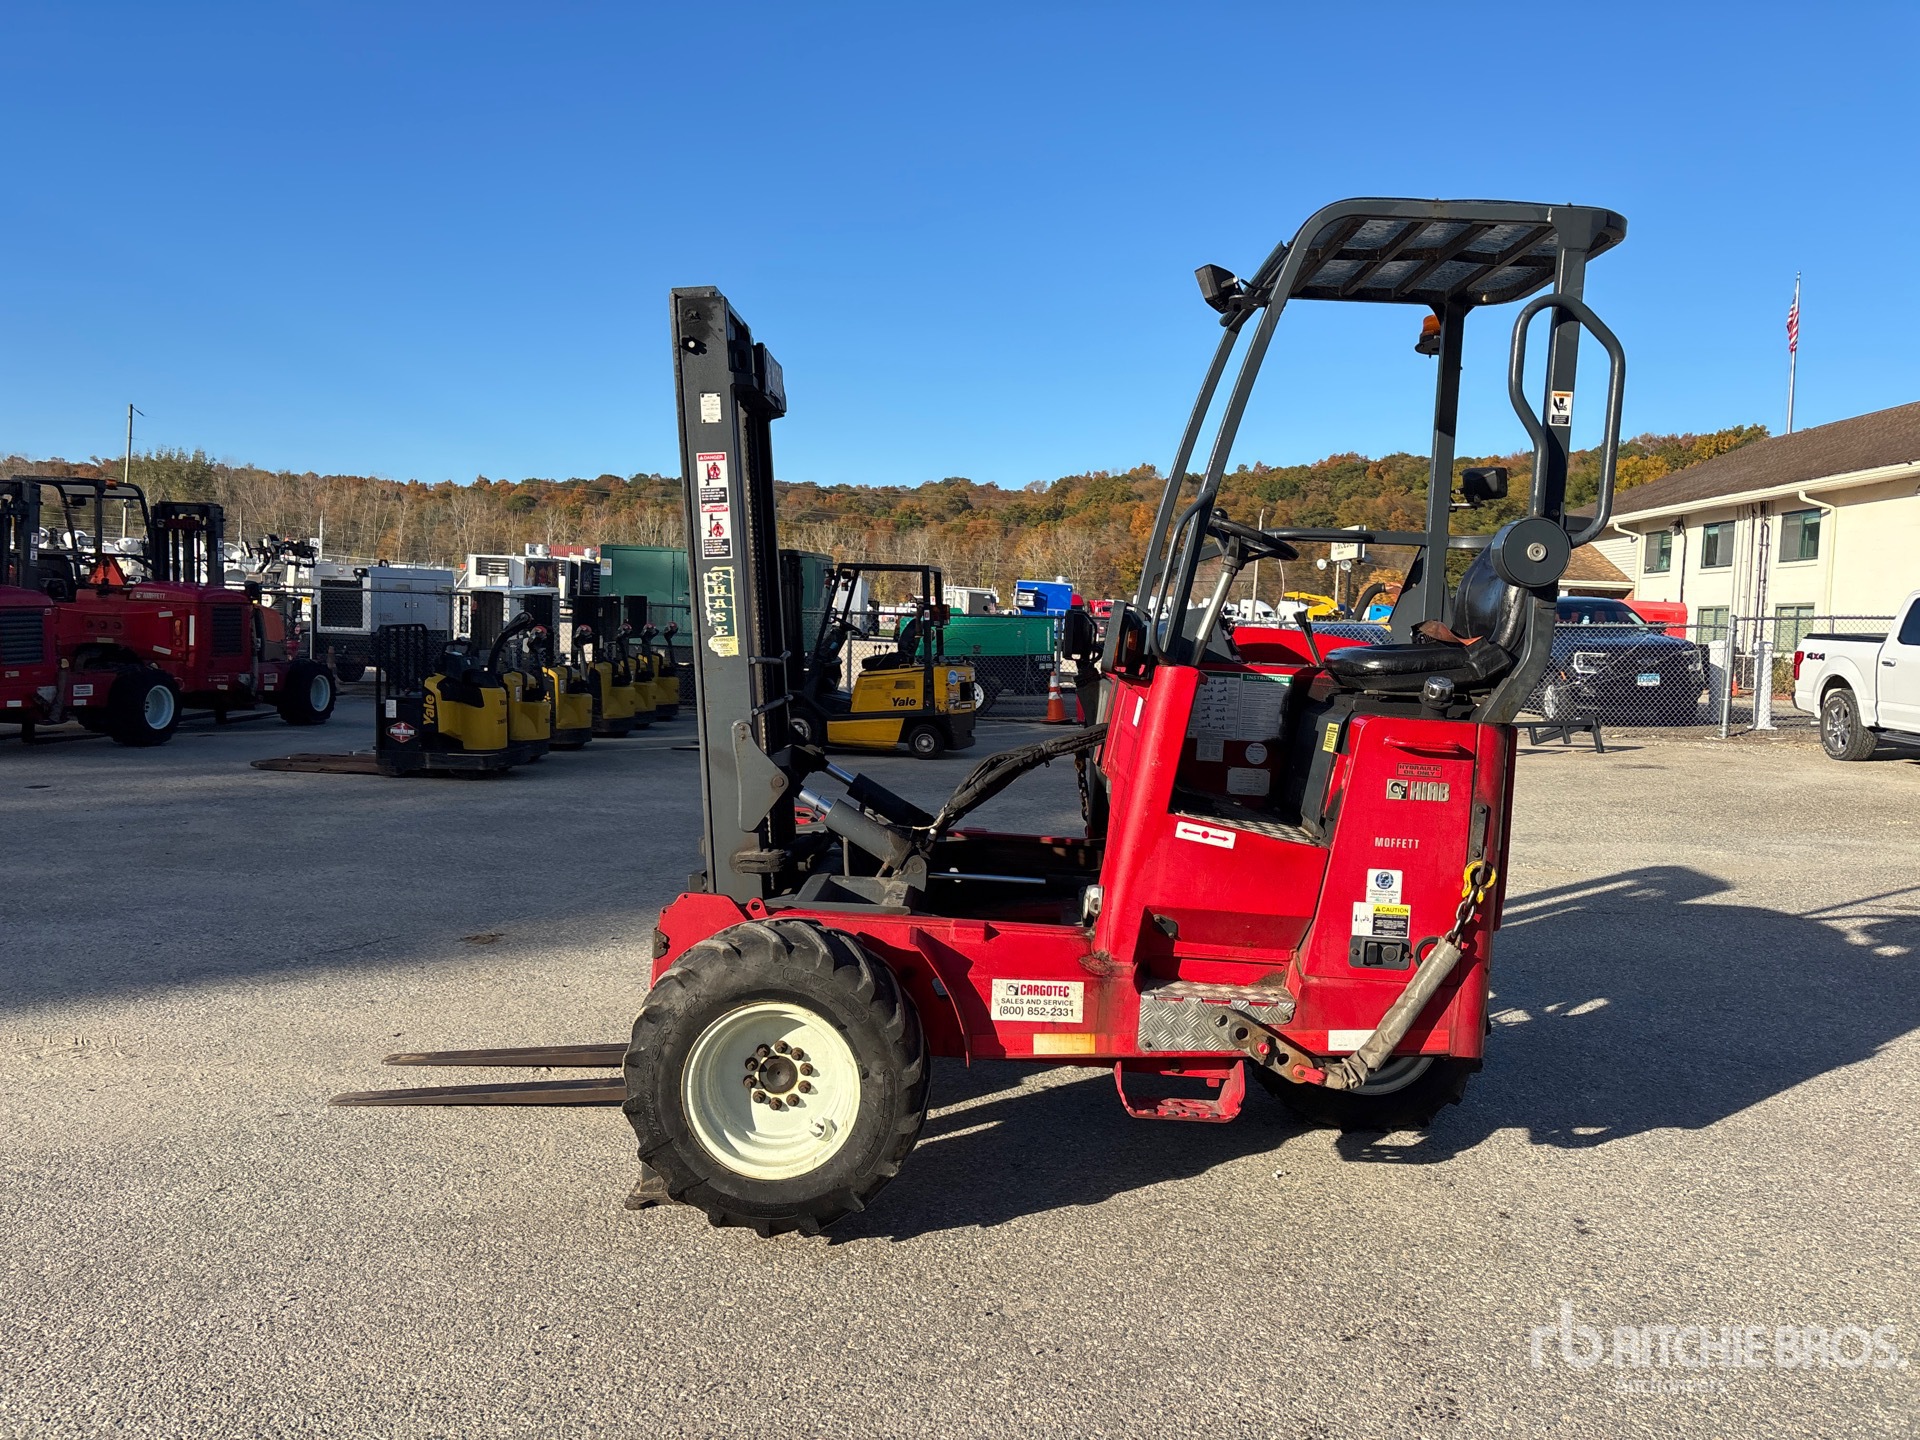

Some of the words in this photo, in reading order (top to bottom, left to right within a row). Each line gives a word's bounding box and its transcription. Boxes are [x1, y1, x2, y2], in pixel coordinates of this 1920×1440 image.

[711, 571, 729, 636] CHASE
[1246, 675, 1290, 683] INSTRUCTIONS
[891, 696, 917, 707] Yale
[422, 694, 435, 726] Yale
[1409, 780, 1450, 802] HIAB
[1374, 836, 1420, 849] MOFFETT
[1381, 906, 1409, 914] CAUTION
[1020, 984, 1070, 998] CARGOTEC
[999, 1005, 1025, 1017] (800)
[1027, 1006, 1074, 1017] 852-2331
